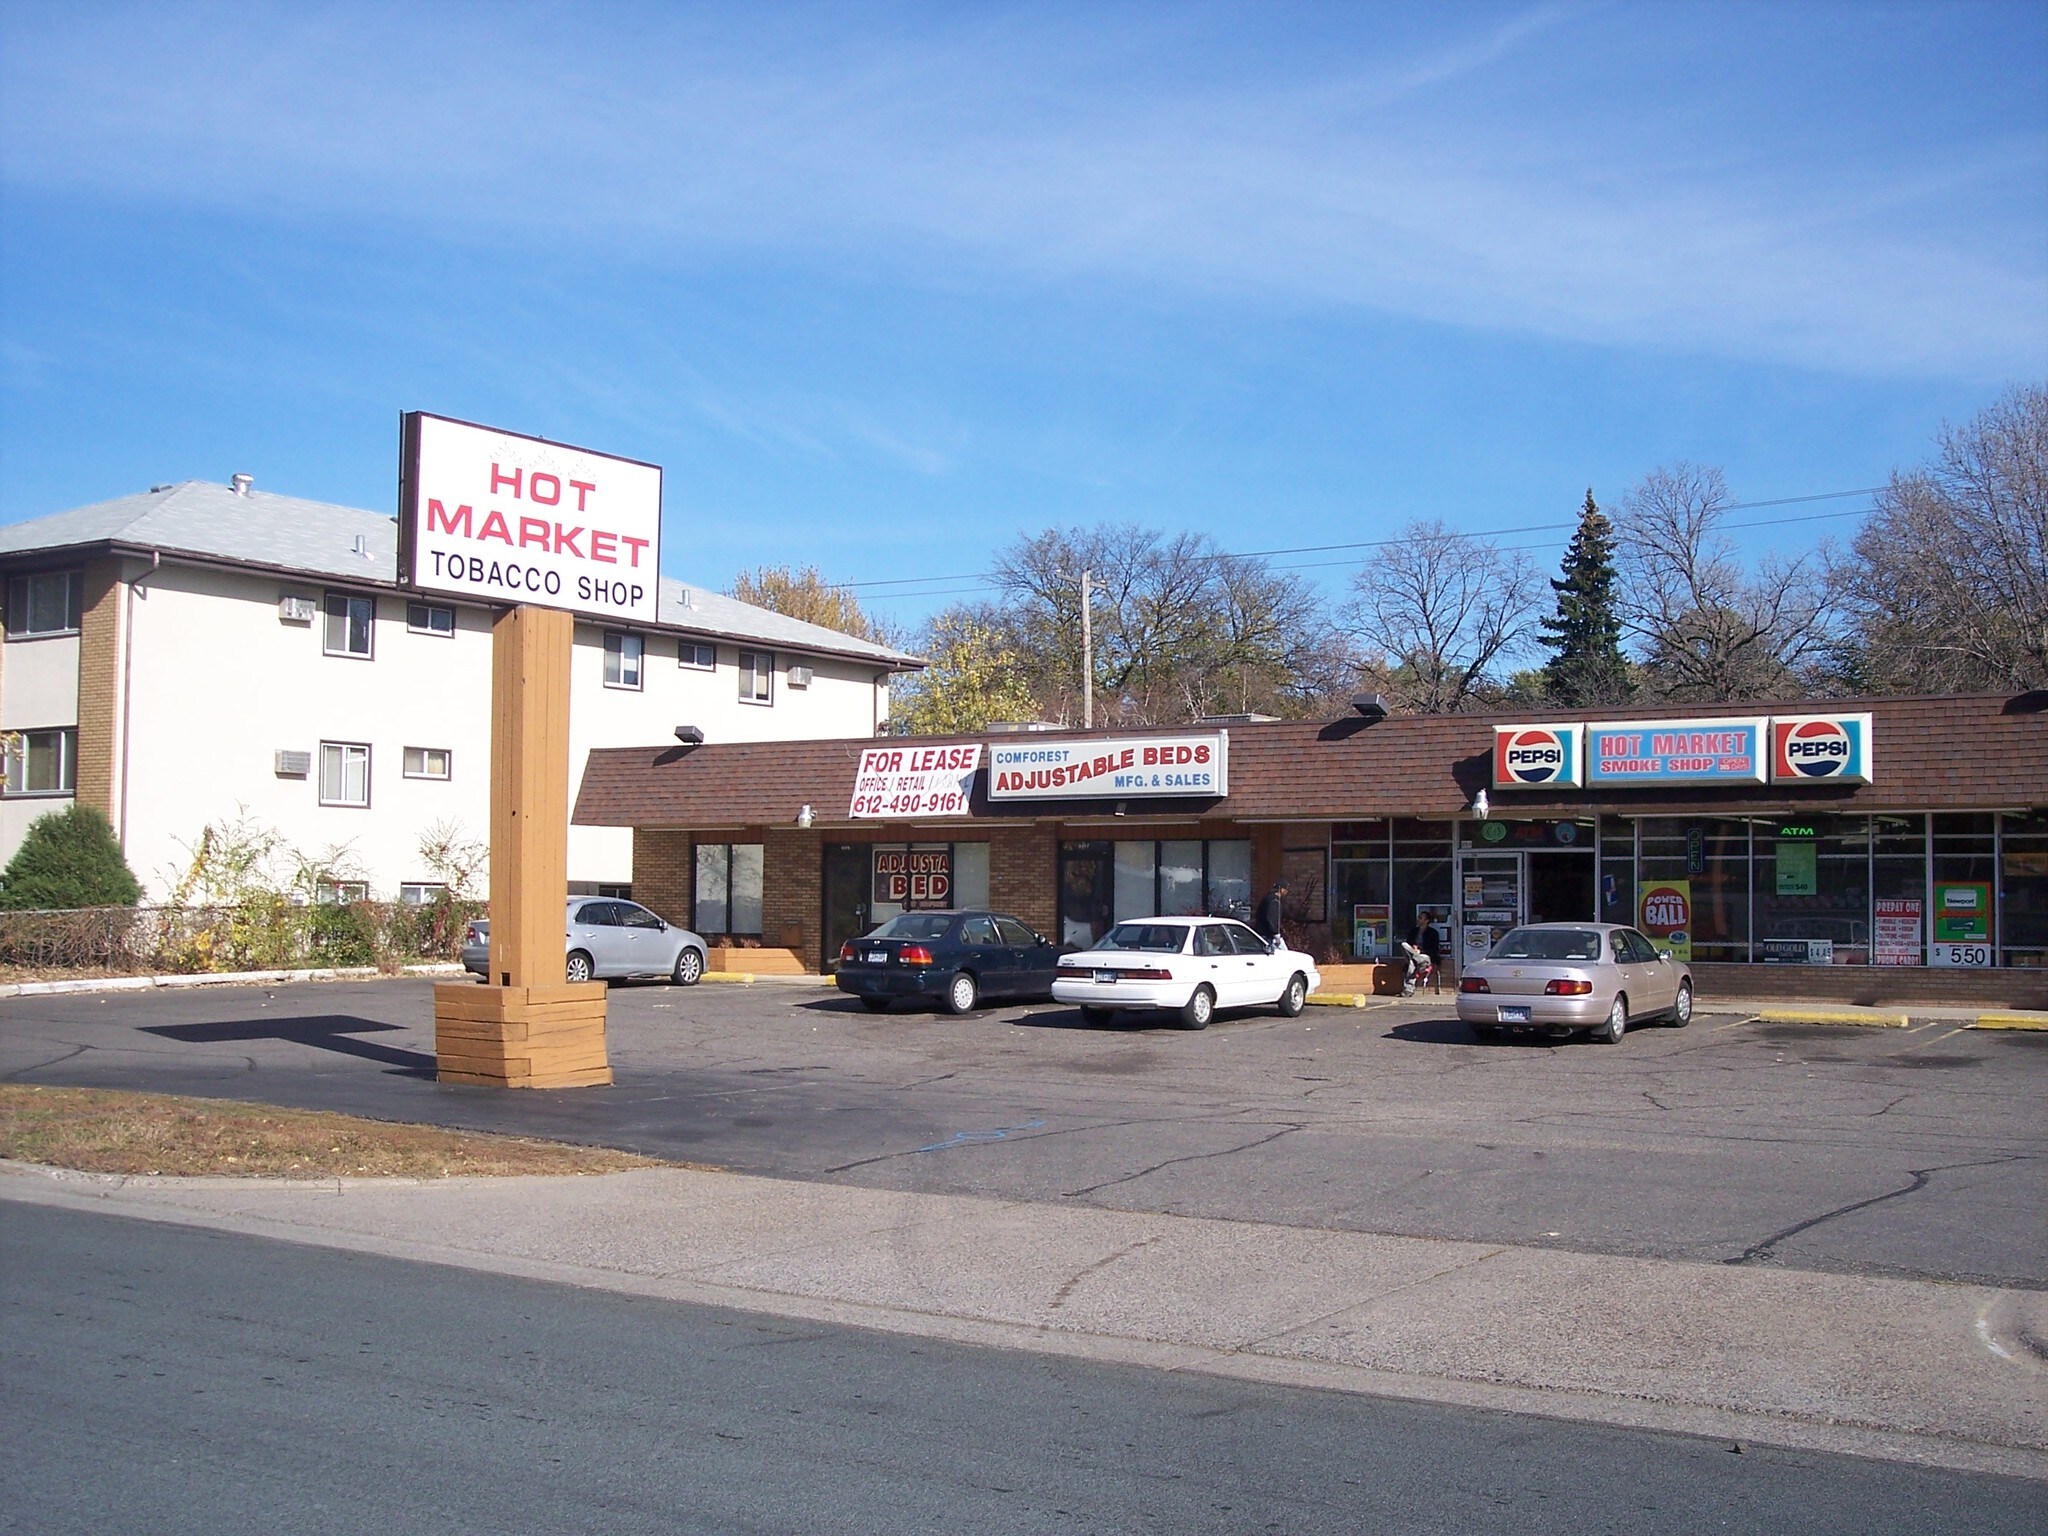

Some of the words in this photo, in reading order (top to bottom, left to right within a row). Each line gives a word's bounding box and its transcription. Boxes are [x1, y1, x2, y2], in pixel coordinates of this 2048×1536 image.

[490, 462, 596, 512] HOT
[427, 498, 650, 567] MARKET
[431, 550, 561, 595] TOBACCO
[577, 576, 644, 607] SHOP
[1600, 735, 1641, 757] HOT
[1653, 732, 1747, 756] MARKET
[1788, 740, 1848, 757] PEPSI
[863, 751, 903, 773] FOR
[910, 748, 976, 772] LEASE
[996, 750, 1070, 764] COMFOREST
[1508, 749, 1561, 764] PEPSI
[1600, 759, 1660, 773] SMOKE
[1668, 758, 1713, 772] SHOP
[995, 748, 1135, 791] ADJUSTABLE
[1143, 745, 1211, 766] BEDS
[859, 777, 888, 792] OFFICE
[896, 775, 925, 791] RETAIL
[1114, 775, 1147, 788] MFG.
[1151, 775, 1161, 787] &
[1165, 773, 1211, 787] SALES
[854, 792, 966, 813] 612-490-9161
[1780, 827, 1814, 835] ATM
[1690, 830, 1700, 870] OPEN
[877, 854, 949, 873] ADJUSTA
[889, 875, 949, 900] BED
[1646, 896, 1683, 905] POWER
[1876, 901, 1904, 912] PREPAY
[1906, 901, 1920, 912] ONE
[1645, 904, 1687, 925] BALL
[1766, 943, 1781, 952] OLD
[1782, 943, 1805, 952] GOLD
[1935, 948, 1941, 957] $
[1951, 948, 1986, 964] 5.50
